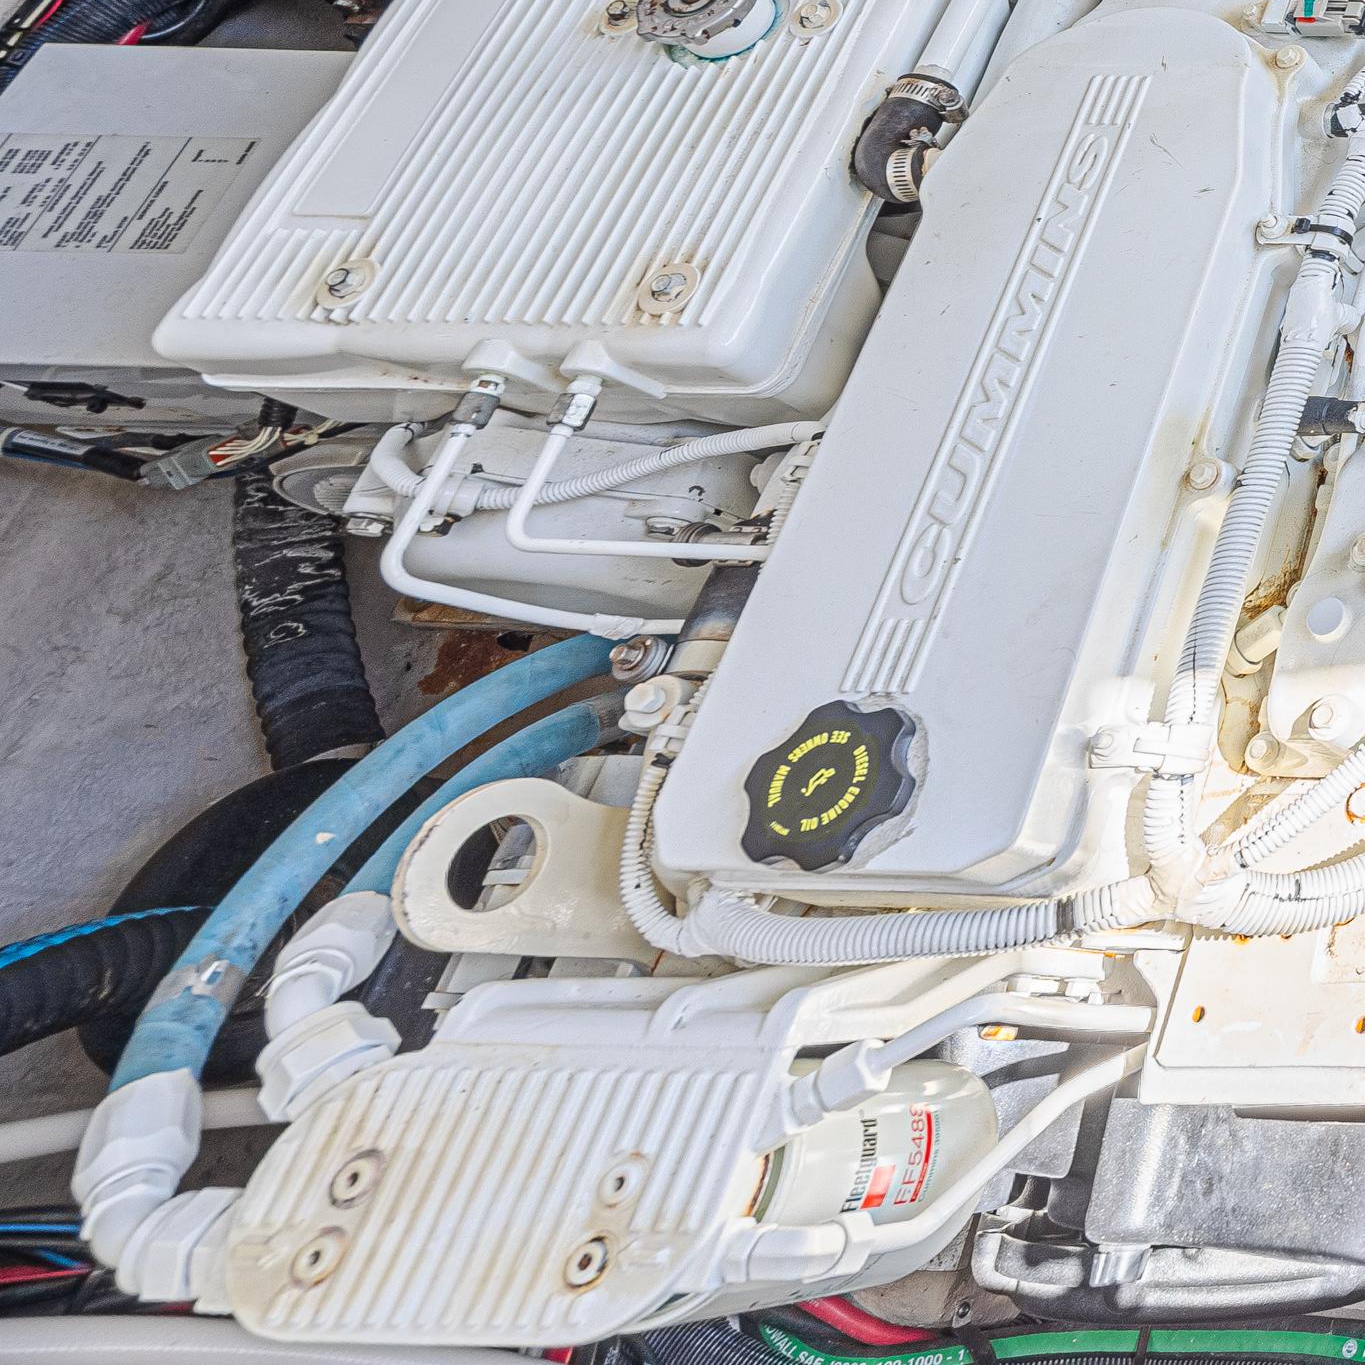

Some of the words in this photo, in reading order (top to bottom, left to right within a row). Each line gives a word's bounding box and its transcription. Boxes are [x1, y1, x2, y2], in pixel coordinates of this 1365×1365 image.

[900, 133, 1108, 606] CUMMINS
[829, 731, 851, 744] SEE
[853, 745, 869, 784] DIESEL
[767, 765, 791, 808] MANUAL
[820, 786, 860, 826] ENGINE
[800, 817, 819, 832] OIL
[839, 1118, 878, 1213] Fleetguard
